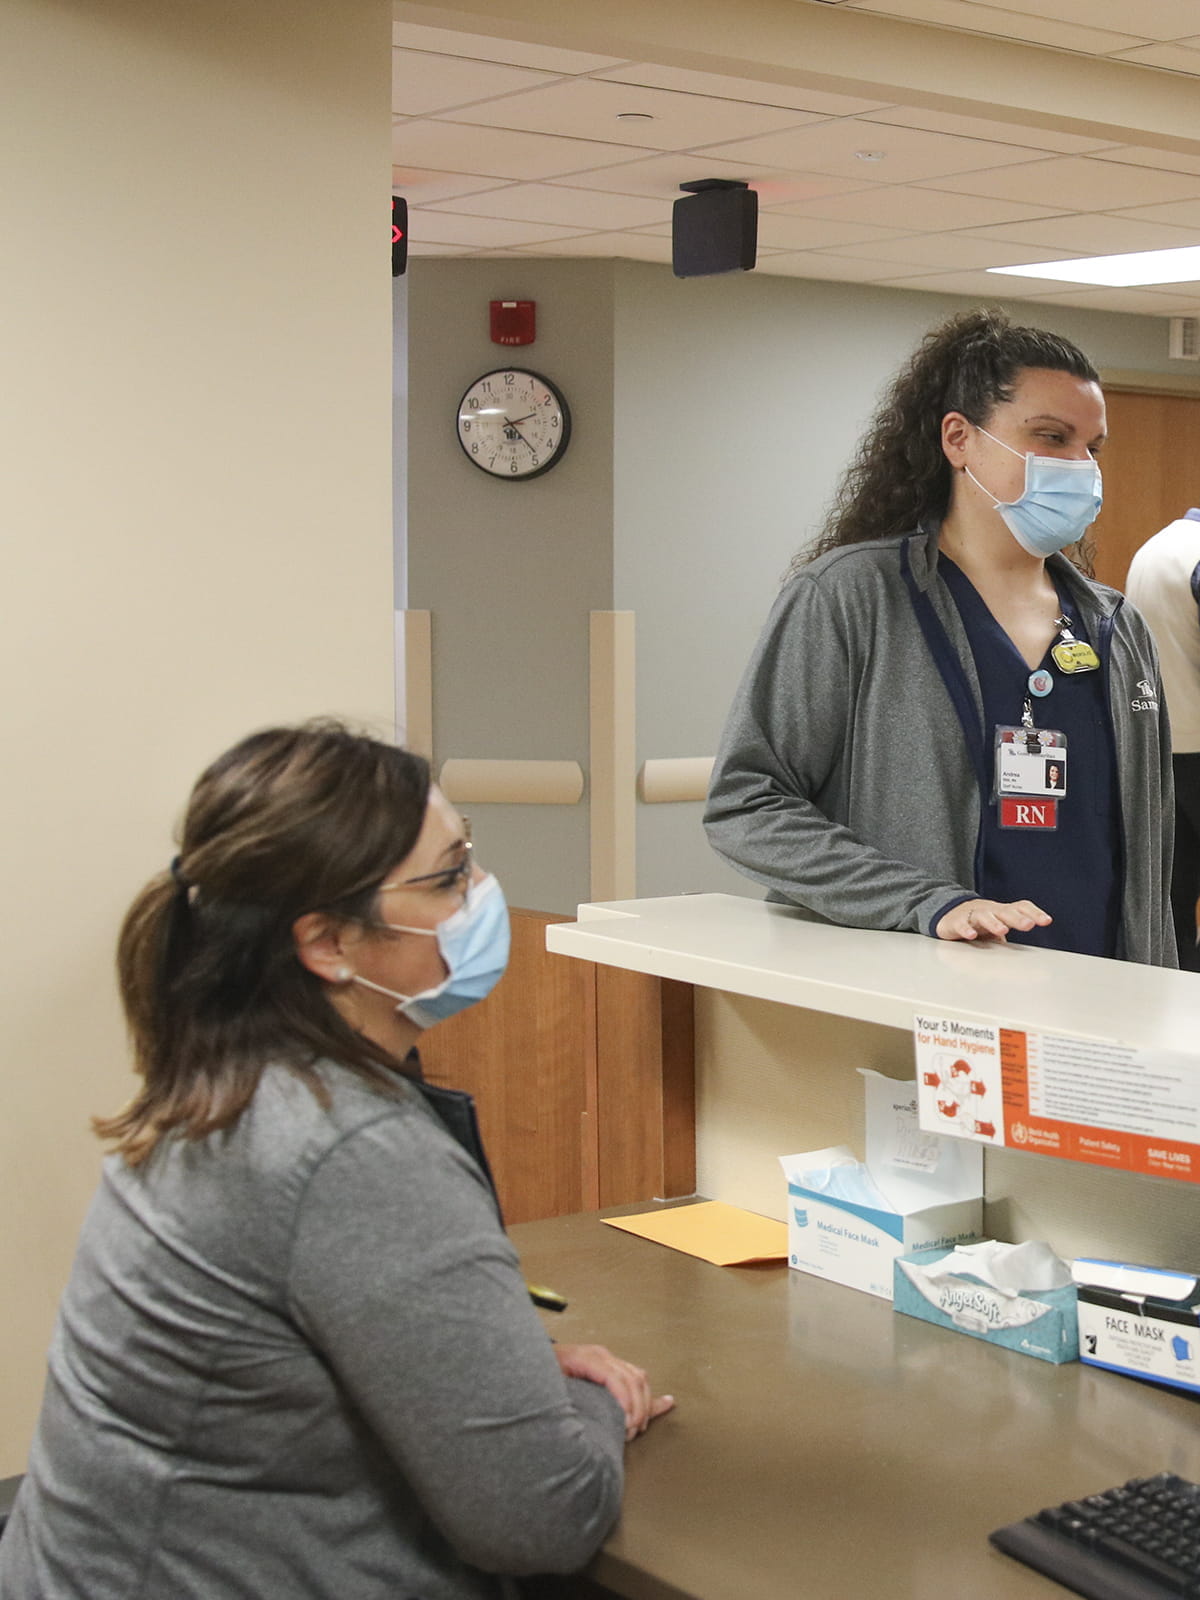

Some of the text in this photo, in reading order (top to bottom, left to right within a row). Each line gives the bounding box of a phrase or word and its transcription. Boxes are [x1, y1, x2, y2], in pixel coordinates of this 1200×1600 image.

[504, 374, 515, 385] 12
[529, 380, 534, 390] 1
[481, 382, 491, 392] 11
[468, 397, 479, 409] 10
[544, 395, 552, 406] 2
[464, 421, 471, 432] 9
[552, 416, 558, 428] 3
[471, 443, 479, 454] 8
[547, 438, 553, 449] 4
[488, 457, 496, 468] 7
[532, 455, 539, 466] 5
[510, 461, 518, 473] 6
[1015, 804, 1047, 825] RN
[916, 1016, 939, 1031] Your
[942, 1020, 948, 1033] 5
[950, 1022, 995, 1041] Moments
[917, 1033, 931, 1044] for
[933, 1034, 958, 1049] Hand
[960, 1039, 995, 1056] Hygiene
[817, 1219, 879, 1248] Medical Face Mask
[912, 1230, 976, 1250] Medical Face Mask
[1105, 1316, 1166, 1343] FACE MASK
